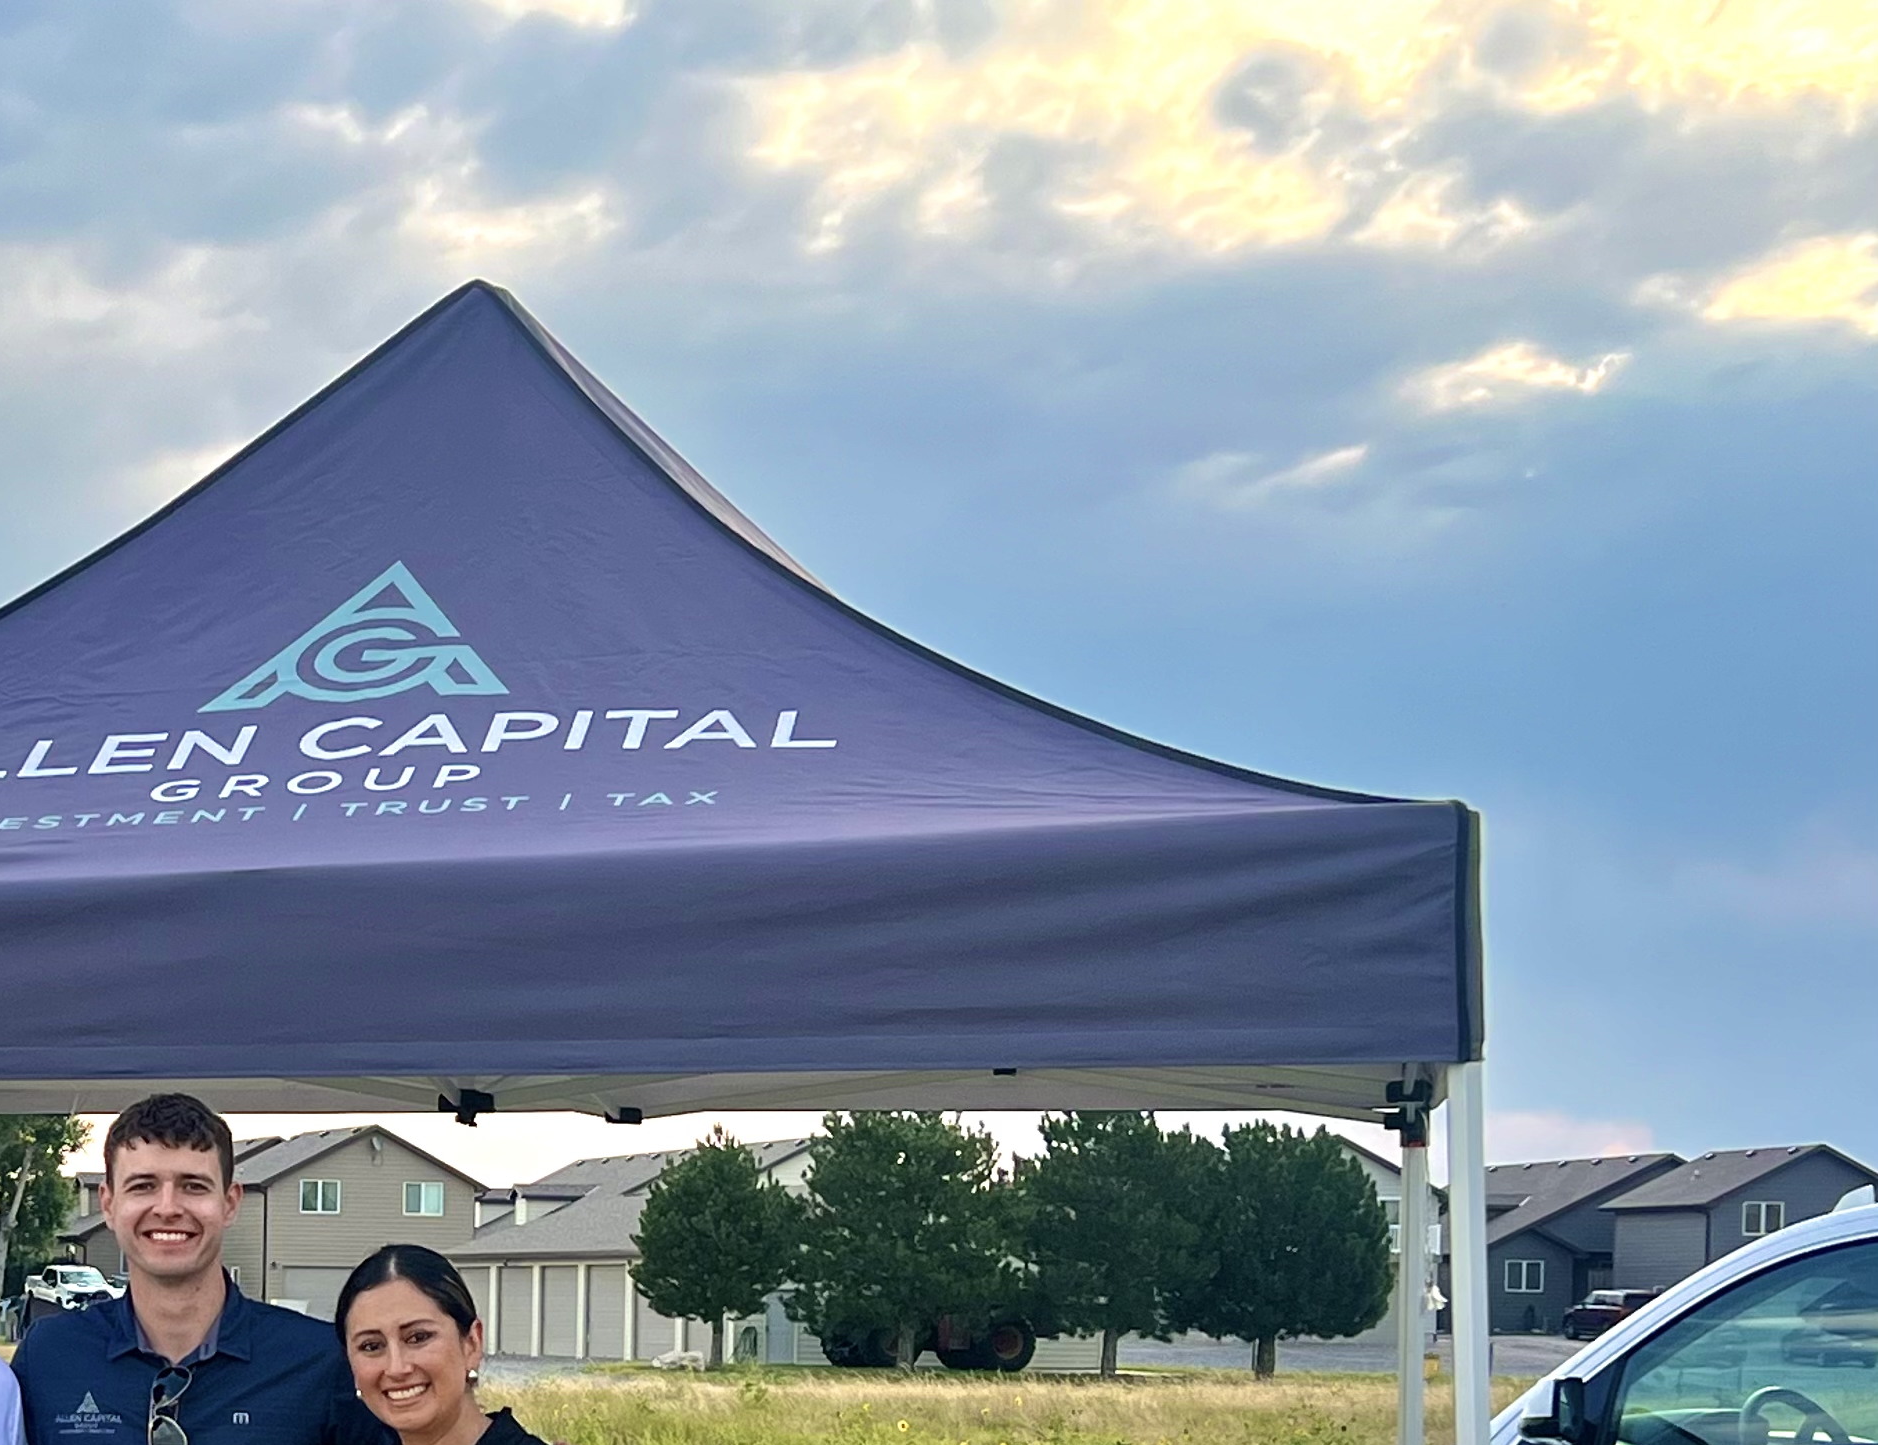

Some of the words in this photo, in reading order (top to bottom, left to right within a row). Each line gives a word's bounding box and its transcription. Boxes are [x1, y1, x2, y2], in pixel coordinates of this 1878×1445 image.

[299, 709, 838, 760] CAPITAL
[150, 764, 482, 802] GROUP
[339, 795, 530, 817] TRUST
[606, 790, 719, 807] TAX
